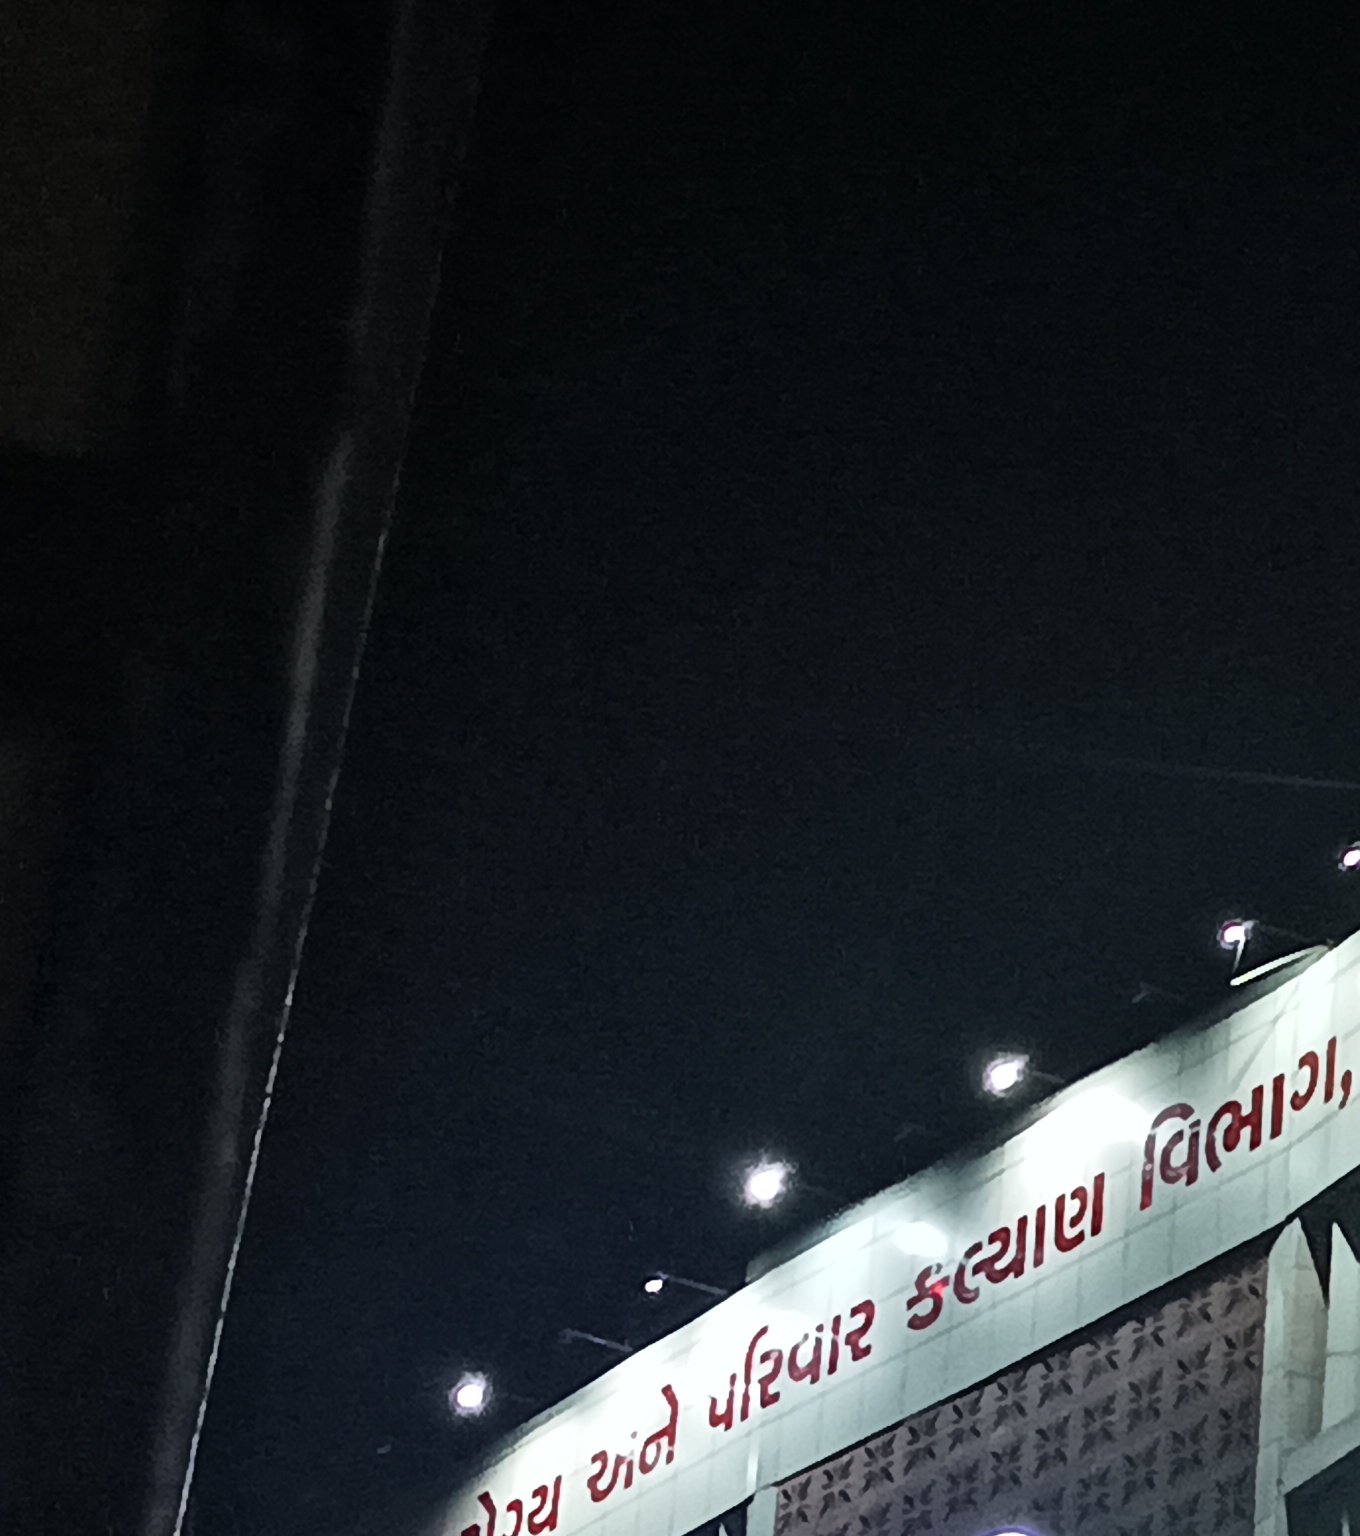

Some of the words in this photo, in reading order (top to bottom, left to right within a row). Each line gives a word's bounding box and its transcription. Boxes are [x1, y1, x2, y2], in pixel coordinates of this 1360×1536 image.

[587, 1383, 679, 1503] અને
[708, 1299, 876, 1431] પરિવાર
[906, 1172, 1106, 1331] કલ્યાણ
[1139, 1035, 1353, 1211] વિભાગ,
